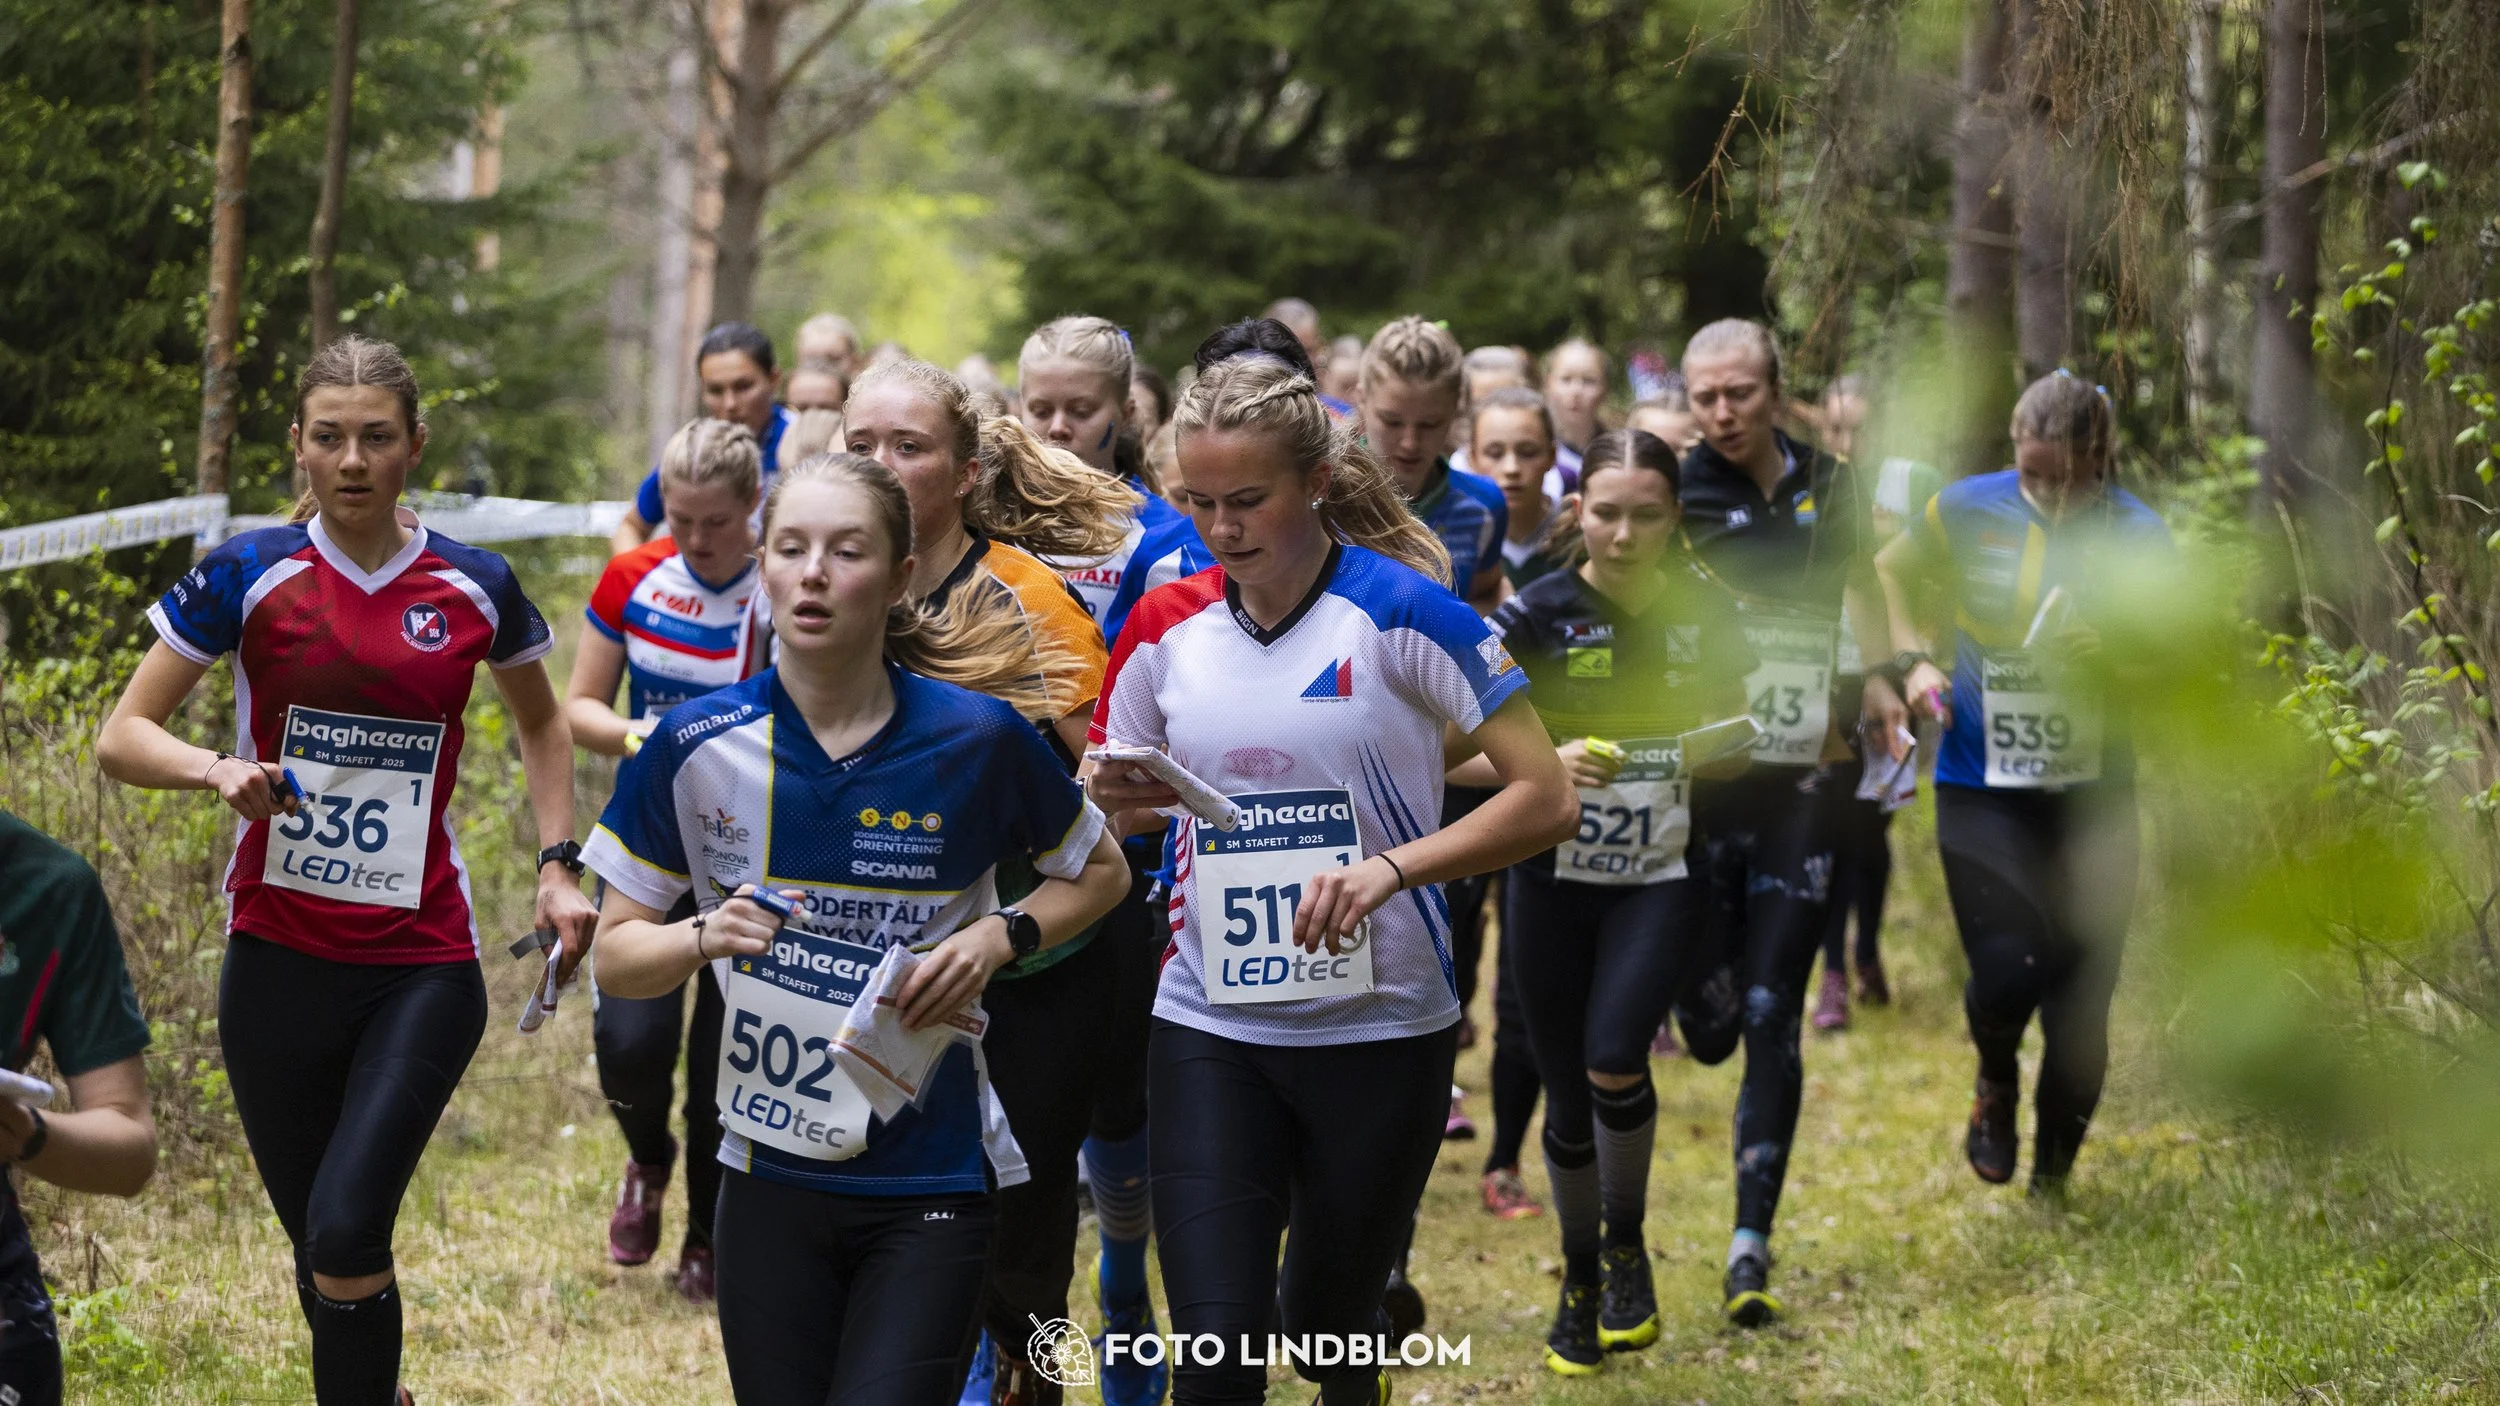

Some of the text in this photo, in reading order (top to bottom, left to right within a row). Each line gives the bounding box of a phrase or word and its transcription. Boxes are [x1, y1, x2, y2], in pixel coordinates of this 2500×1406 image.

[1751, 686, 1804, 726] 43
[291, 712, 435, 751] bagheera
[676, 705, 752, 744] noname
[1992, 713, 2070, 752] 539
[315, 750, 405, 768] SM STAFETT 2025
[410, 779, 422, 806] 1
[1671, 784, 1681, 804] 1
[278, 791, 390, 853] 536
[697, 815, 750, 845] Telge
[1576, 801, 1652, 846] 521
[853, 839, 944, 854] ORIENTERING
[1226, 834, 1324, 849] SM STAFETT 2025
[282, 849, 404, 892] LEDtec
[851, 860, 937, 879] SCANIA
[804, 890, 945, 925] ÖDERTÄLJ
[761, 967, 856, 1002] SM STAFETT 2025
[1222, 955, 1350, 987] LEDtec
[727, 1008, 835, 1103] 502
[731, 1084, 846, 1149] LEDtec
